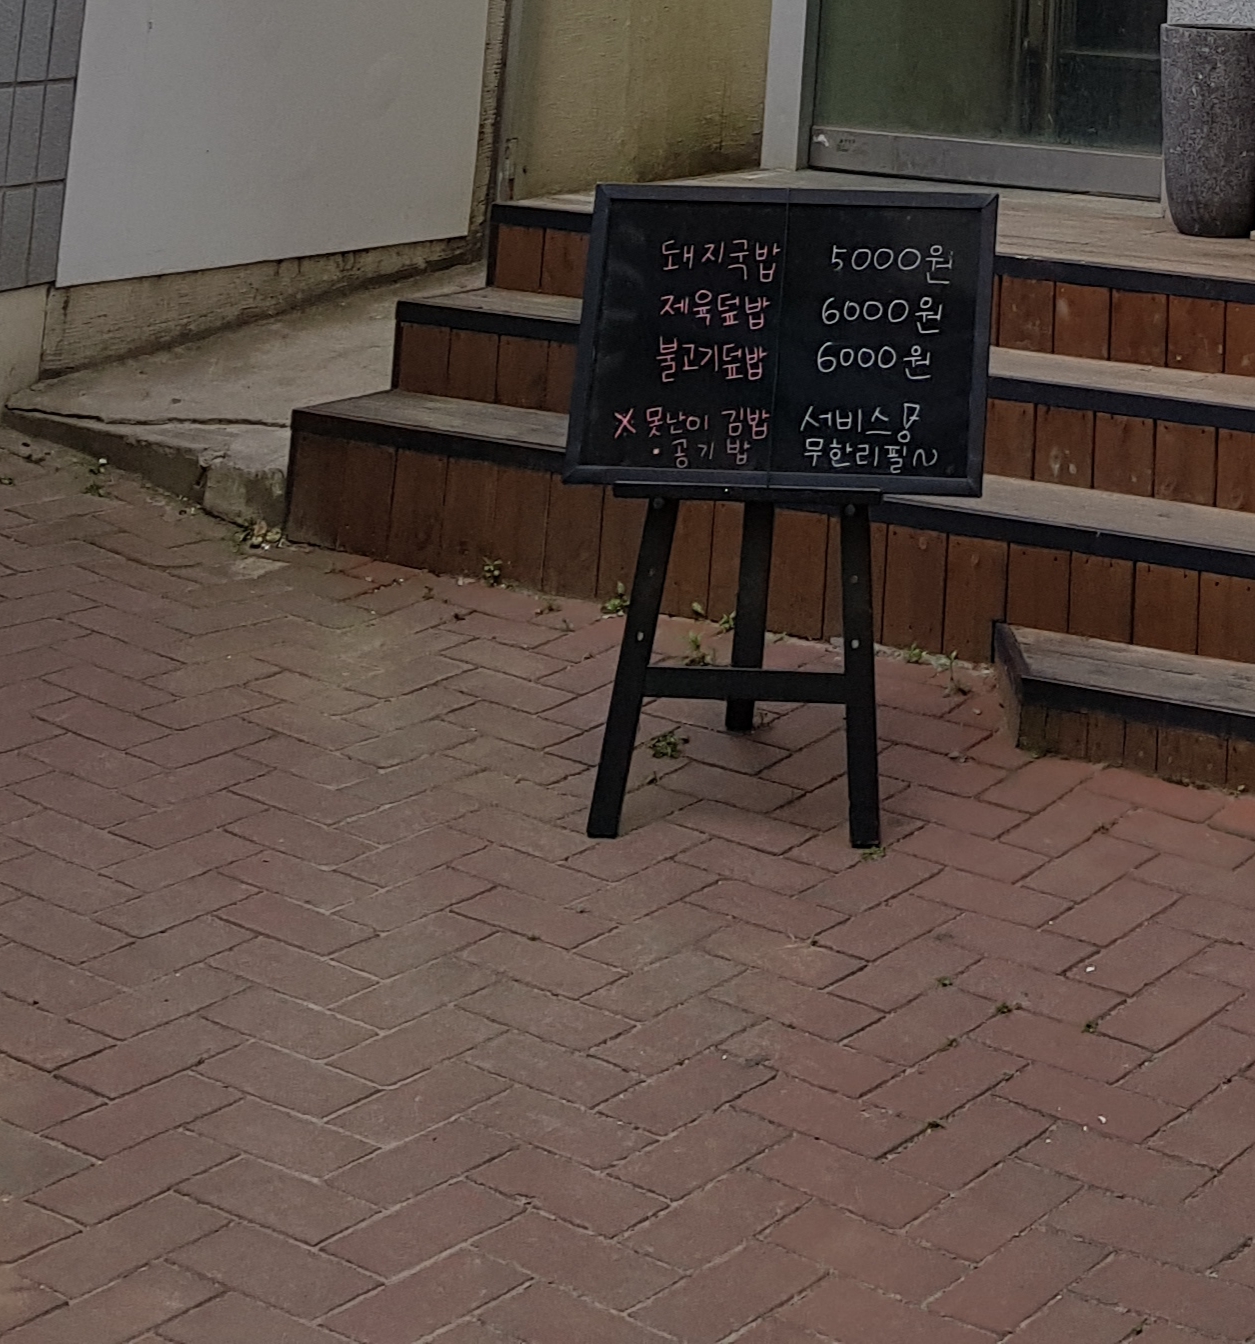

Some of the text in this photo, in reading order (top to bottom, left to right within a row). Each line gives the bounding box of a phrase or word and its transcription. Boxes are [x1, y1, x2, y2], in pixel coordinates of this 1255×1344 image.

[661, 239, 953, 284] 돼지국밥 5000원
[660, 289, 943, 333] 제육덮밥 6000원
[656, 335, 931, 382] 불고기덮밥 6000원
[646, 406, 708, 437] 못난이
[721, 406, 770, 440] 김밥
